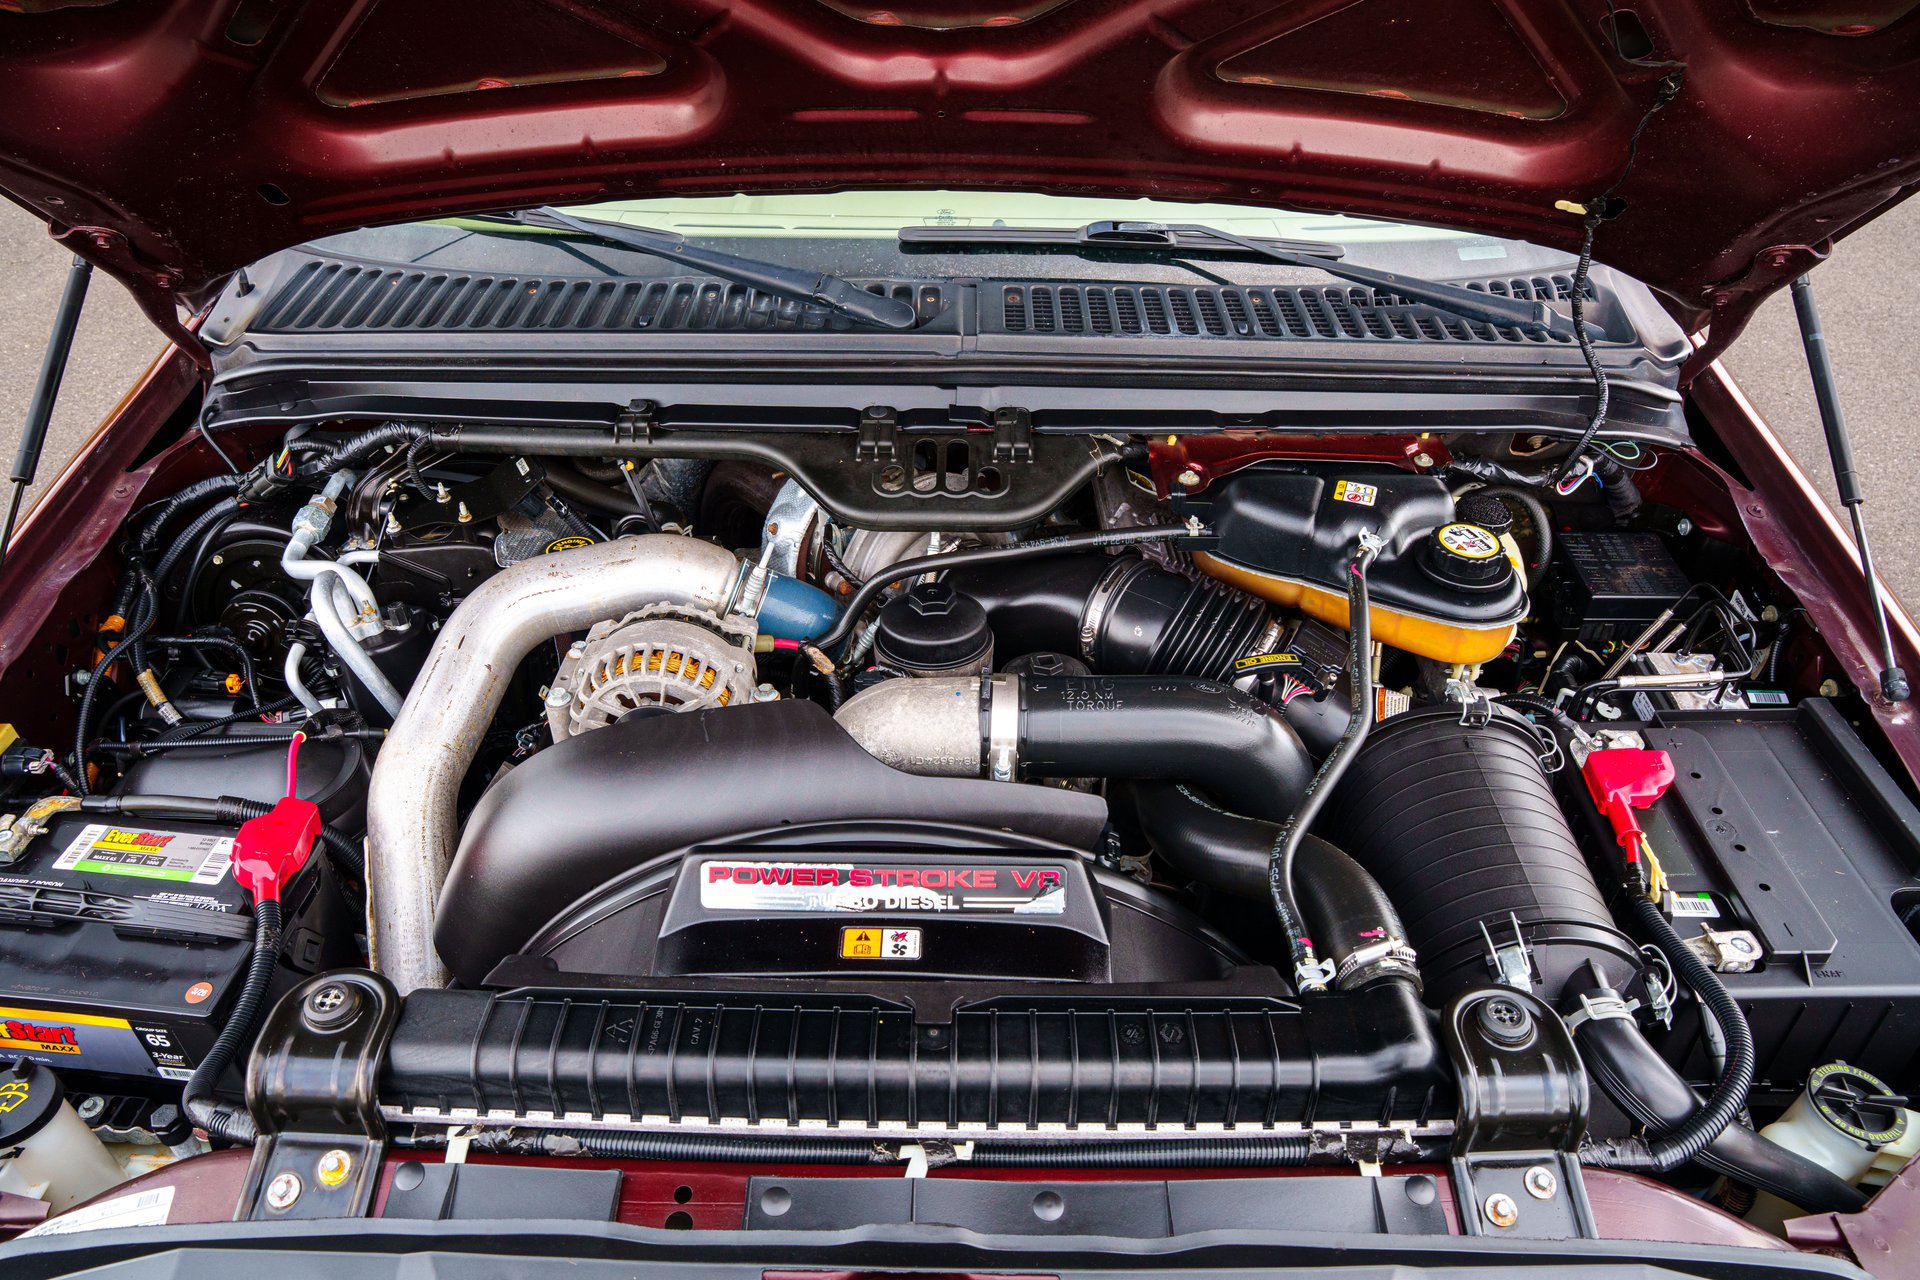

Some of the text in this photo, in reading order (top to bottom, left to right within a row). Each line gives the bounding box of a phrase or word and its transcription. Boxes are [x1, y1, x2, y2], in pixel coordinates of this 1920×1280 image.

[1244, 654, 1291, 666] ENGINE OIL
[1066, 700, 1124, 711] TORQUE
[102, 828, 174, 847] EverStart
[708, 866, 1061, 889] POWER STROKE V8
[885, 895, 960, 910] DIESEL
[40, 1043, 76, 1053] MAXX
[145, 1033, 171, 1048] 65
[152, 1051, 184, 1061] 3-Year
[1853, 1068, 1879, 1085] FLUID
[1834, 1118, 1903, 1141] DO NOT OVERFILL
